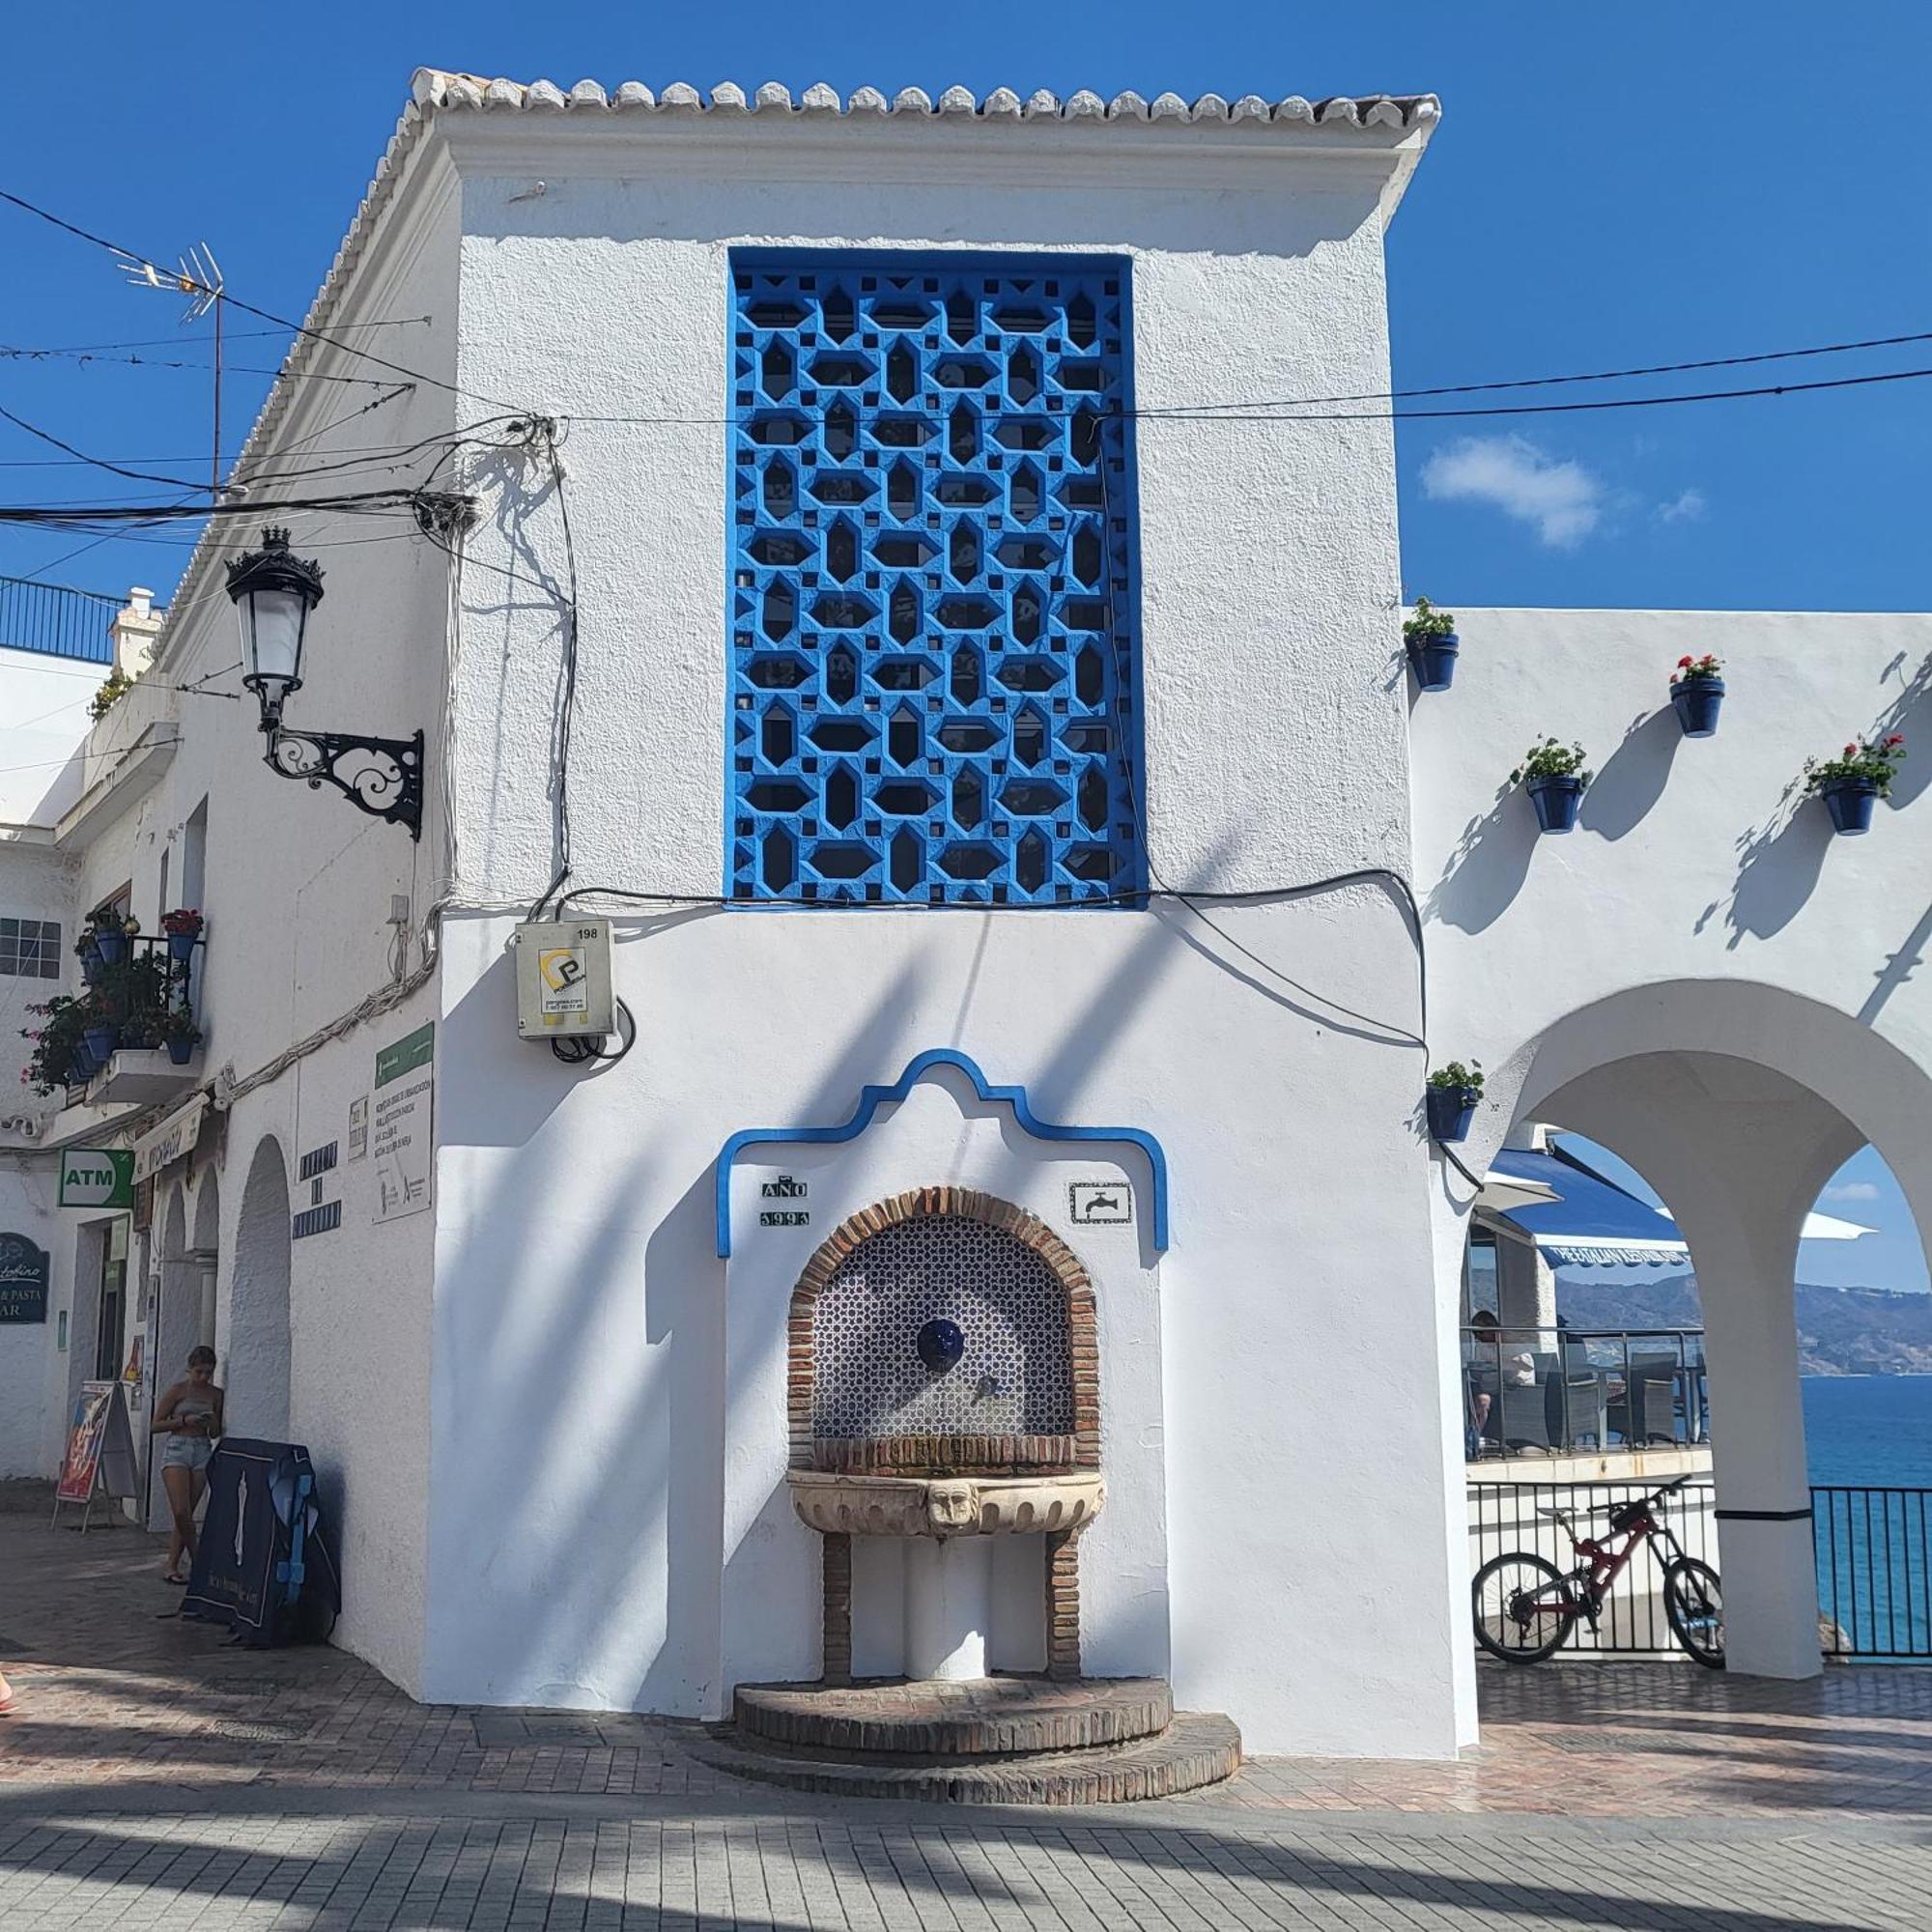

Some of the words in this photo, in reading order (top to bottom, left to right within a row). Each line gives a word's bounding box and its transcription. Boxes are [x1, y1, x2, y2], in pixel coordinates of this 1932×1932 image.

[577, 928, 598, 940] 198
[66, 1170, 113, 1186] ATM
[763, 1176, 807, 1197] AÑO
[11, 1290, 42, 1300] PASTA
